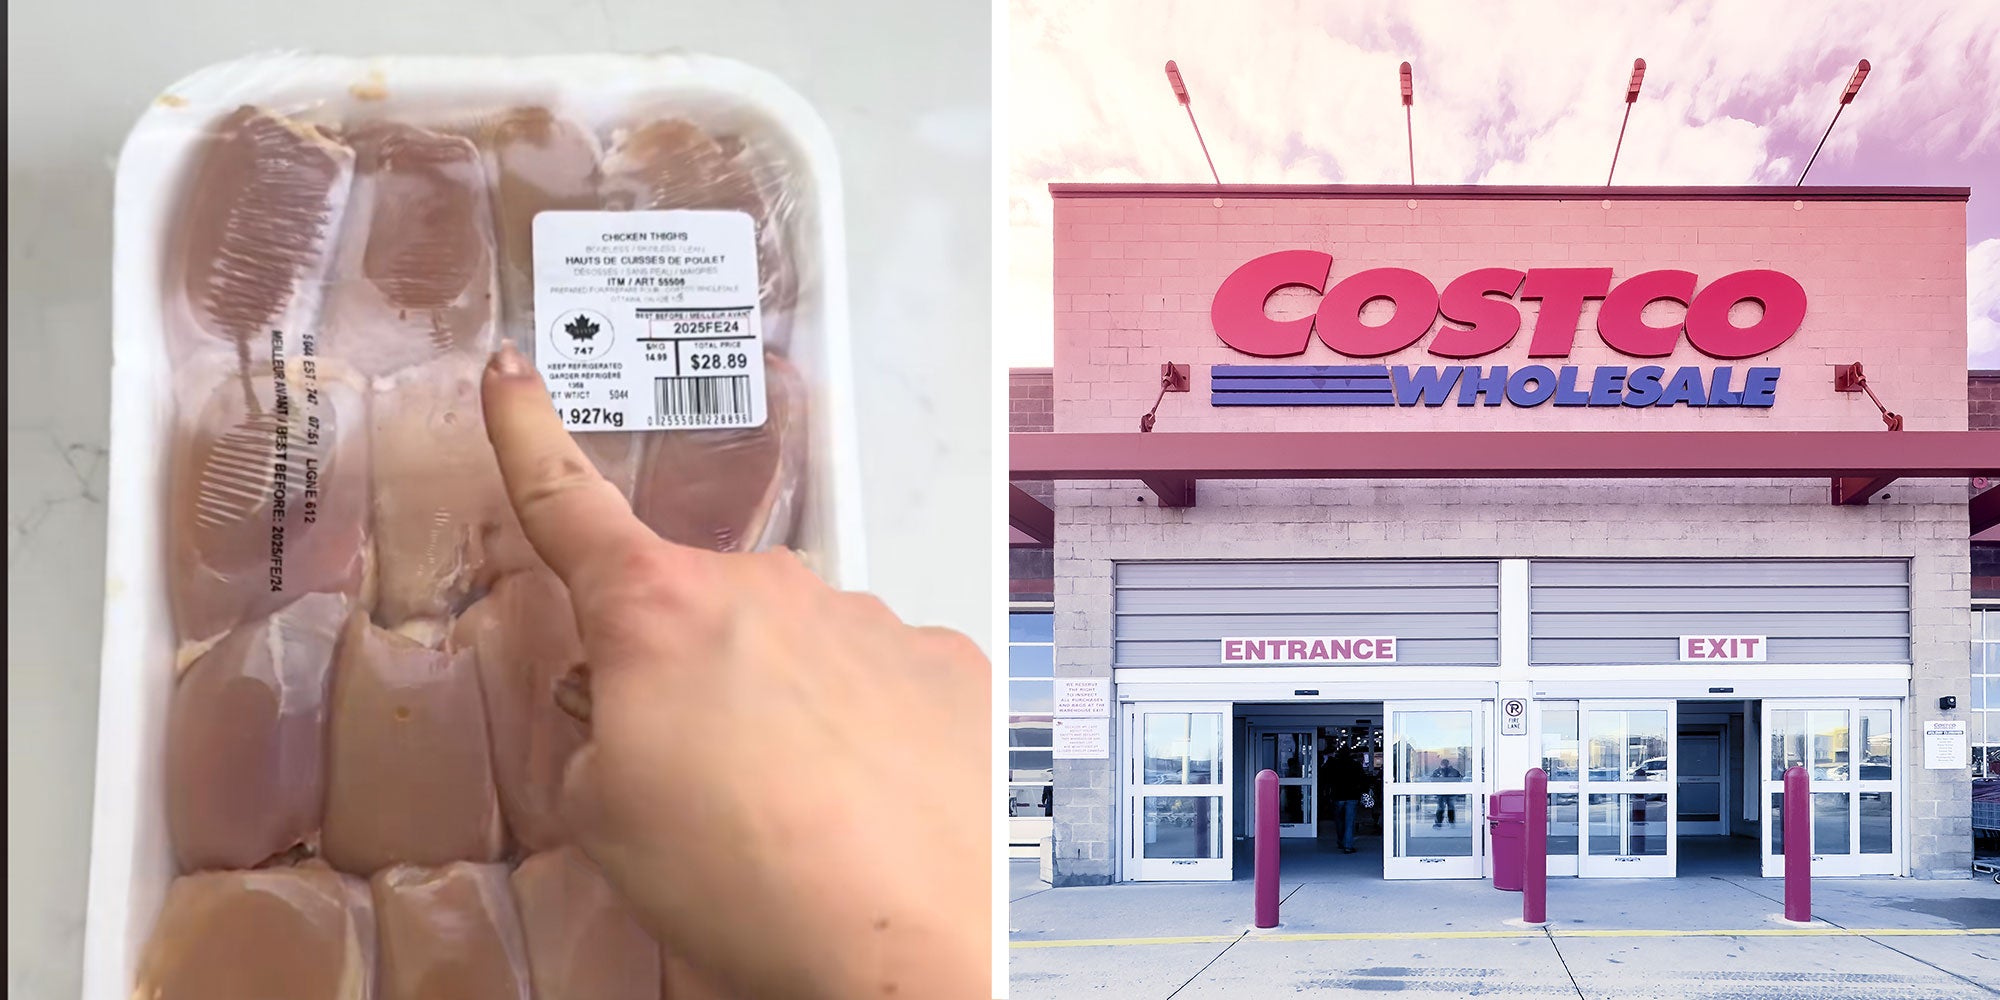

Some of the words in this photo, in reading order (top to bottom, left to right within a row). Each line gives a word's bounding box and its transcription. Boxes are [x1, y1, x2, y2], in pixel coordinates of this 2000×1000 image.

[602, 232, 647, 242] CHICKEN
[650, 232, 688, 241] THIGHS
[566, 256, 600, 265] HAUTS
[604, 256, 616, 265] DE
[621, 255, 665, 265] CUISSES
[668, 255, 681, 265] DE
[685, 255, 725, 264] POULET
[607, 278, 625, 286] ITM
[634, 278, 654, 286] ART
[1211, 249, 1808, 360] COSTCO
[674, 321, 739, 334] 2025FE24
[271, 330, 284, 380] MEILLEUR
[645, 353, 667, 361] 14.99
[690, 353, 748, 370] $28.89
[303, 361, 316, 380] EST
[306, 388, 318, 405] 747
[609, 389, 629, 400] 5044
[1391, 364, 1782, 408] WHOLESALE
[276, 382, 288, 416] AVANT
[307, 416, 319, 445] 07:51
[275, 426, 288, 460] BEST
[305, 459, 318, 498] LIGNE
[273, 464, 286, 521] BEFORE:
[304, 502, 316, 524] 612
[270, 526, 285, 592] 2025/FE/24
[1224, 638, 1394, 660] ENTRANCE
[1687, 638, 1760, 659] EXIT
